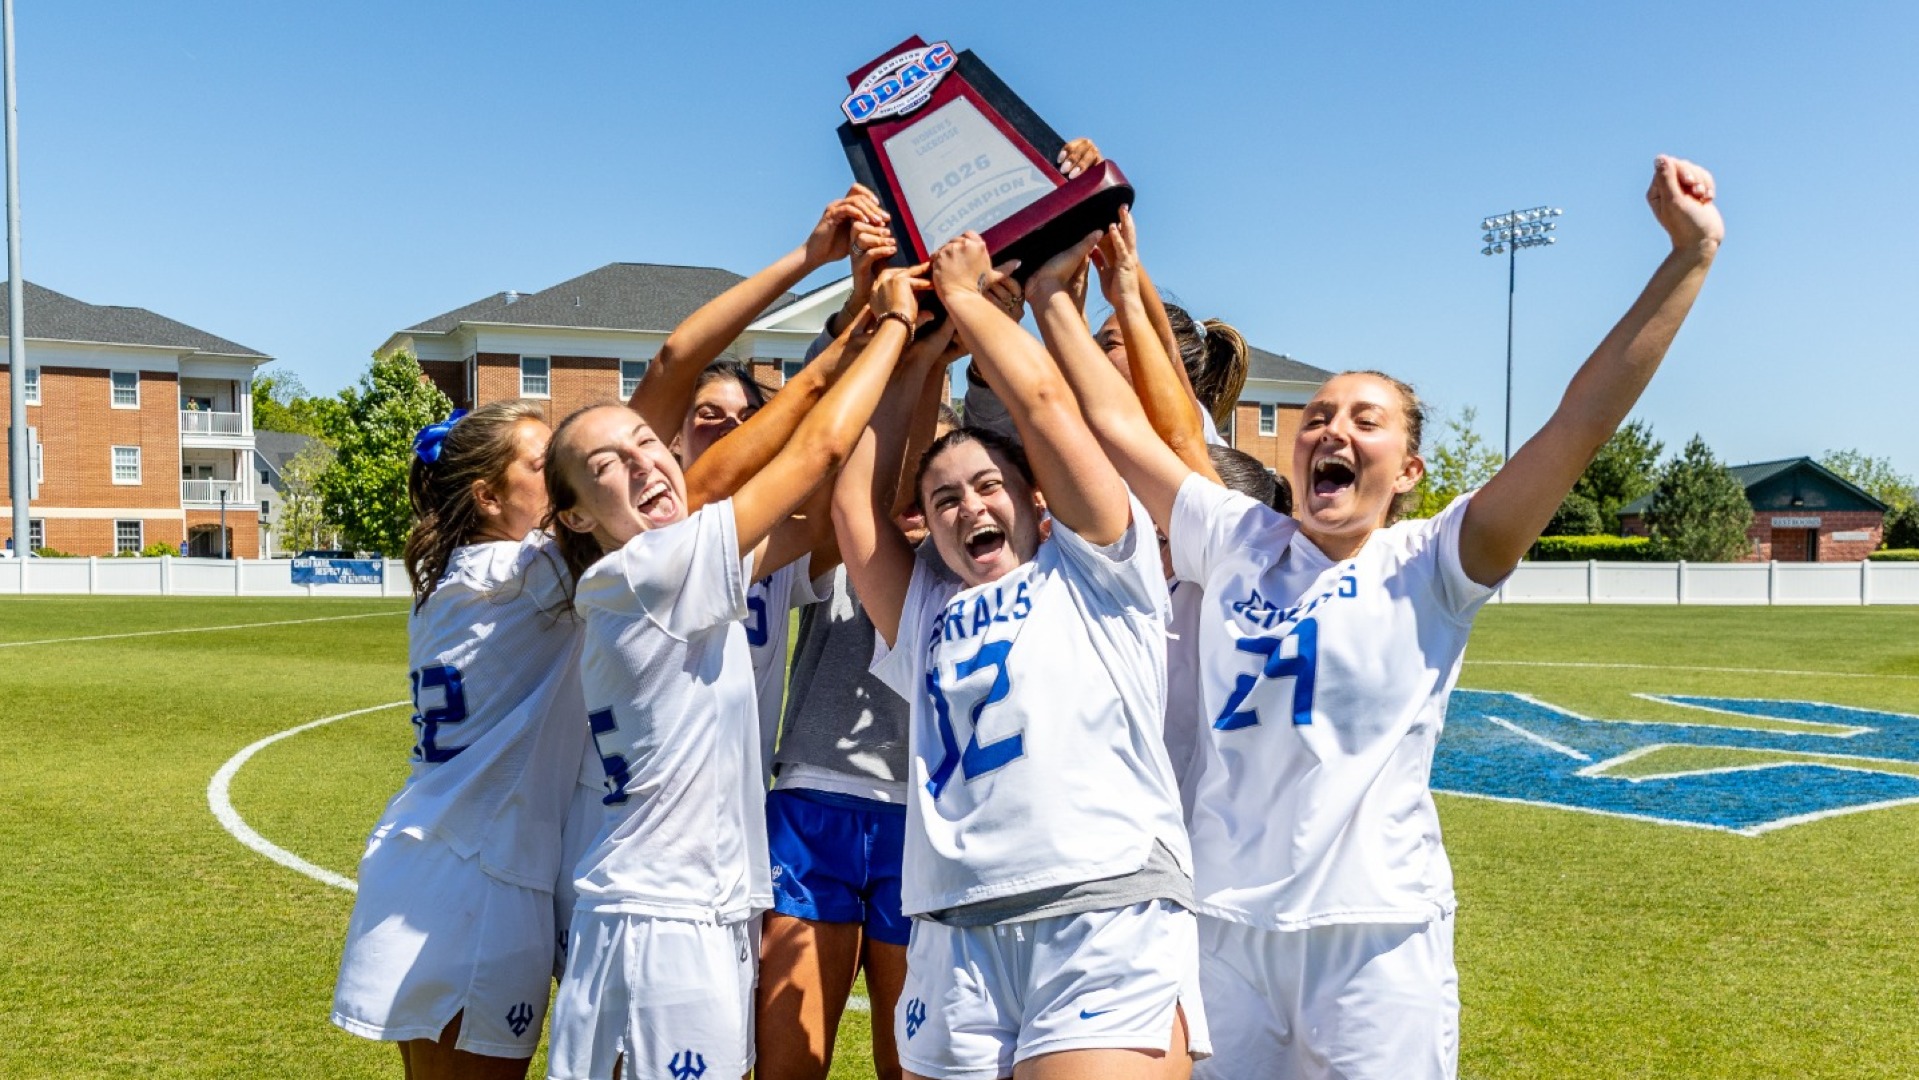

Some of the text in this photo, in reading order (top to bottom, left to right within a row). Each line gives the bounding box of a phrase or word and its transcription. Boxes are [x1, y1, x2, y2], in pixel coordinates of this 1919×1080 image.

[845, 44, 956, 121] ODAC
[915, 126, 961, 156] LACROSSE
[929, 153, 992, 199] 2026
[937, 176, 1026, 234] CHAMPION
[315, 568, 341, 576] RESPECT
[1213, 617, 1318, 730] 29
[926, 639, 1026, 800] 12
